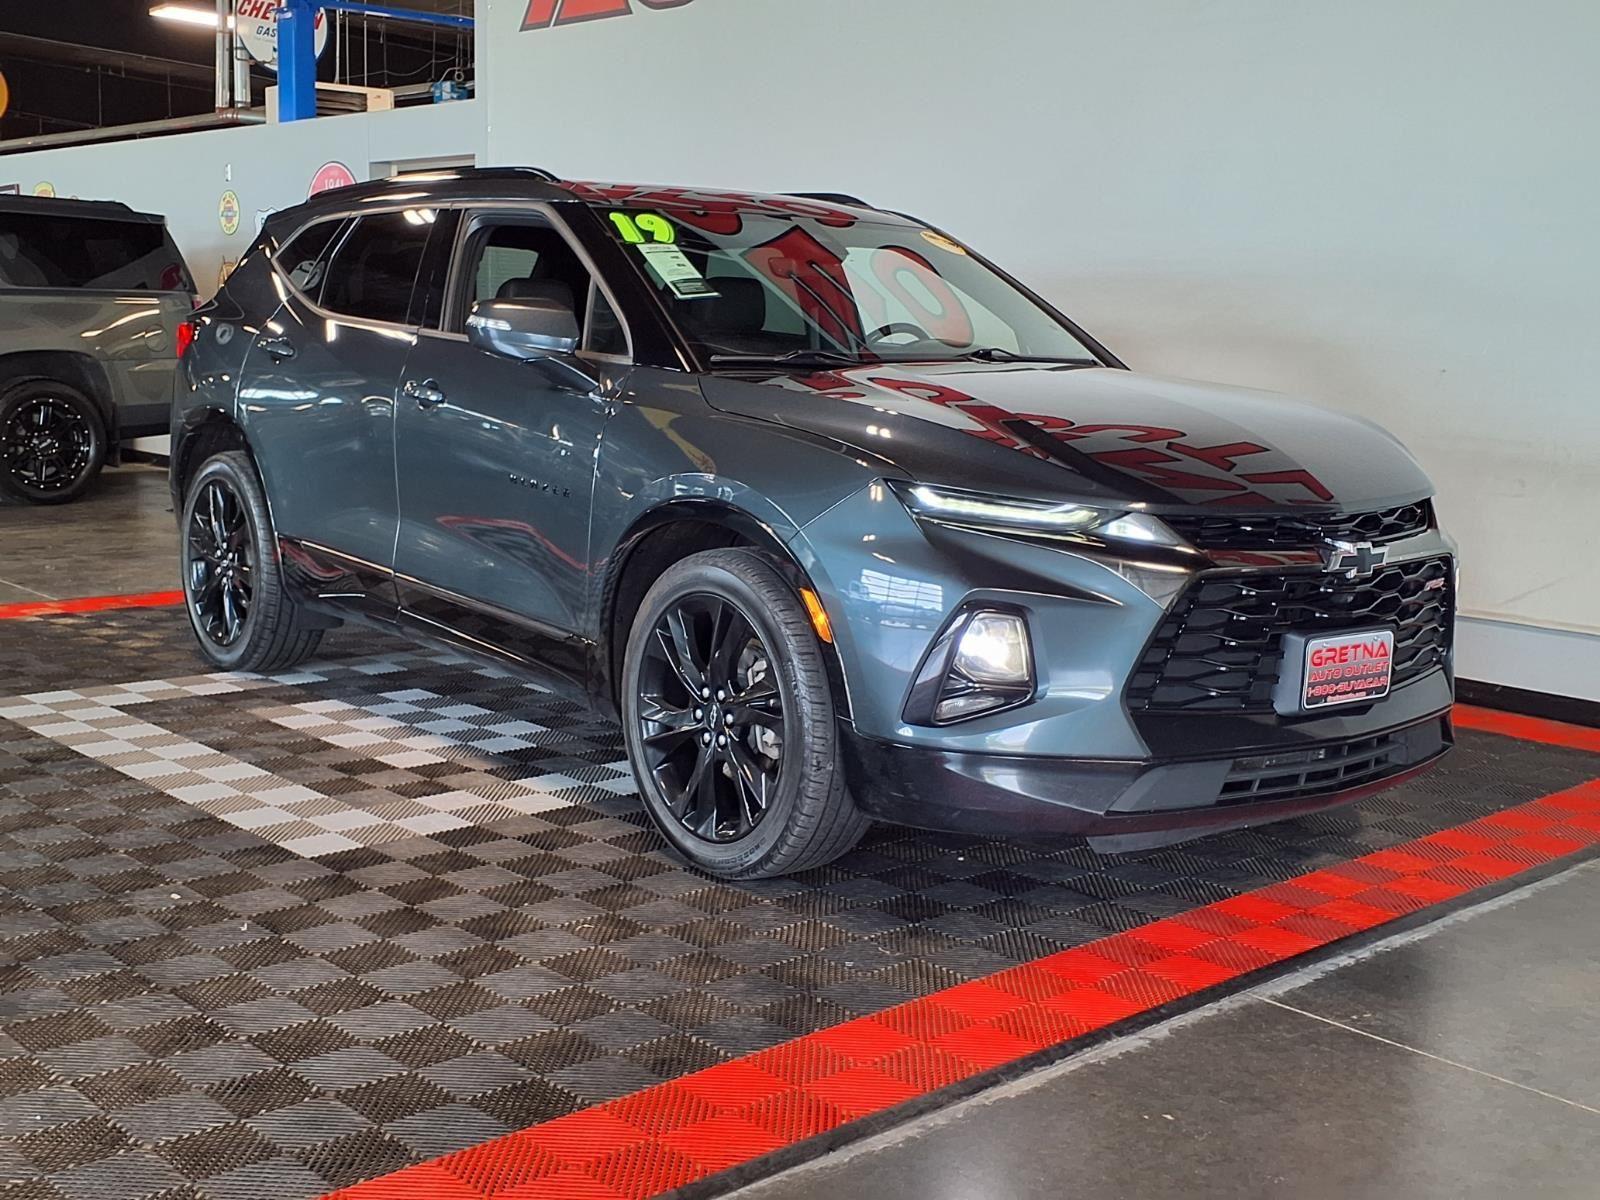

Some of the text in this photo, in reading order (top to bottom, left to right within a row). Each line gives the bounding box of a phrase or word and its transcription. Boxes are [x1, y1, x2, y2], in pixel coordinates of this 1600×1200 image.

[609, 212, 675, 243] 19
[1311, 640, 1389, 668] GRETNA
[1309, 660, 1389, 682] AUTO OUTLET
